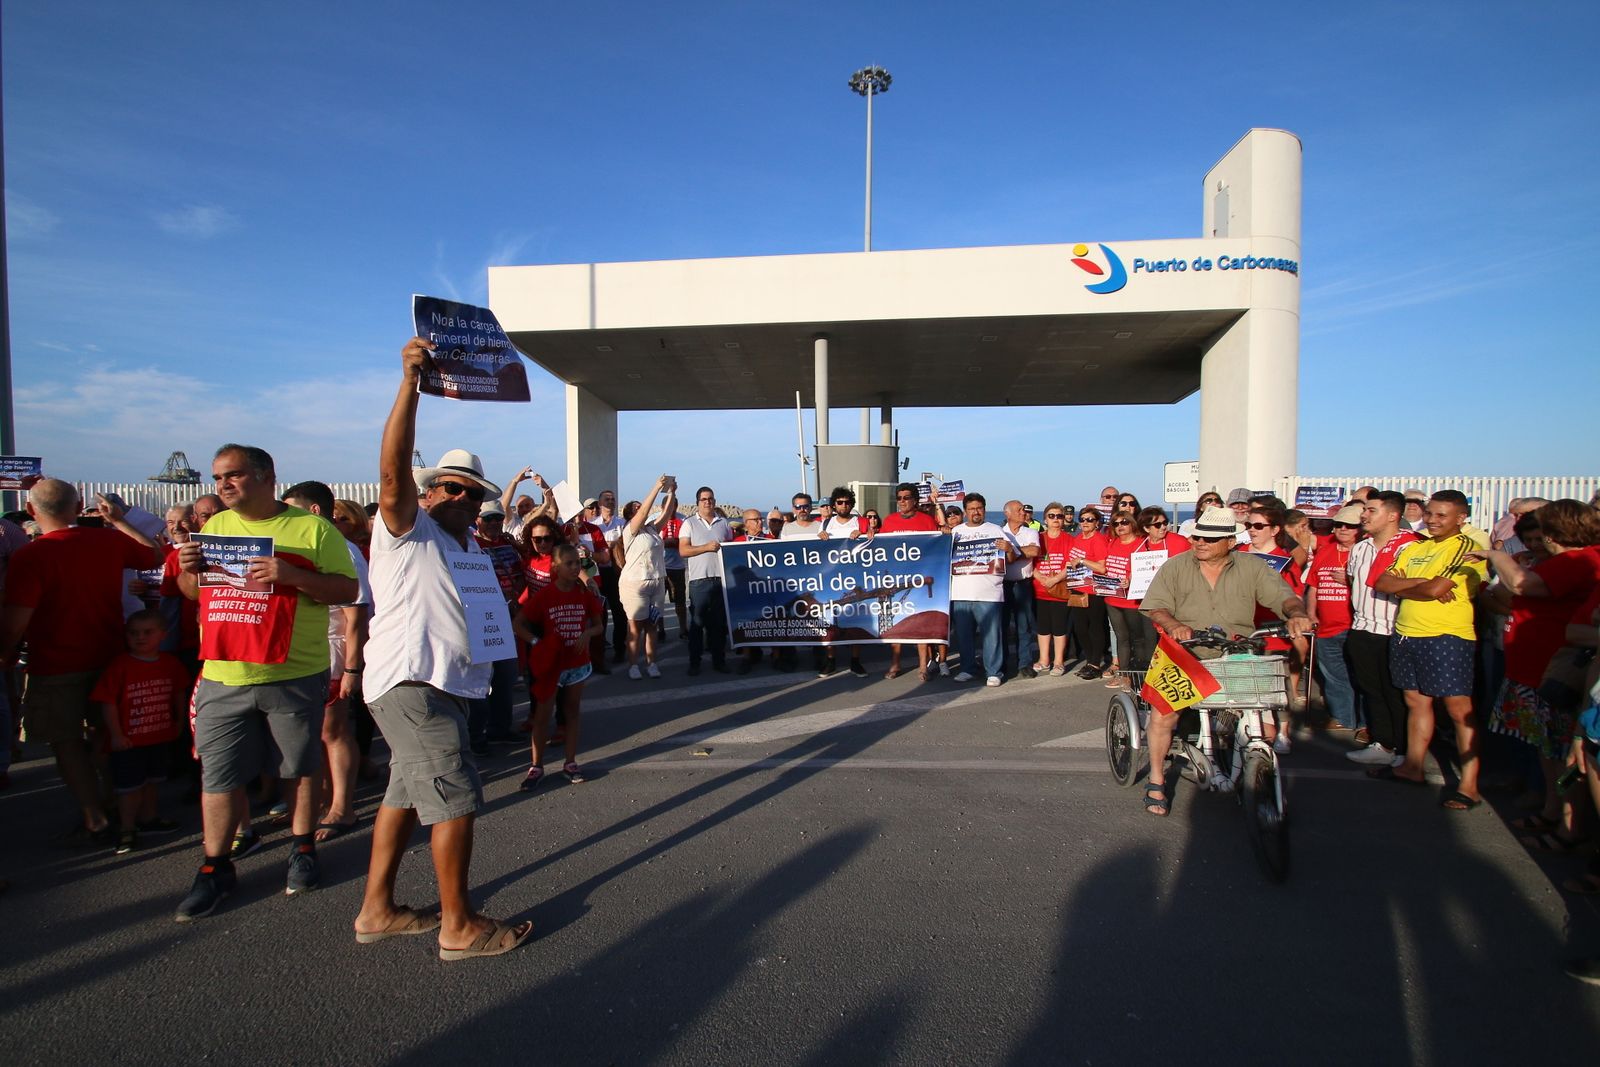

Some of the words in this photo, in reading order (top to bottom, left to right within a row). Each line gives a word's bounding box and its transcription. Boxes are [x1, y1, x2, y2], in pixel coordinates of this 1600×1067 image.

[1133, 257, 1188, 273] Puerto
[1192, 256, 1212, 272] de
[1217, 255, 1298, 277] Carboneras
[432, 311, 448, 326] No
[448, 317, 454, 327] a
[457, 316, 468, 328] la
[470, 319, 495, 333] carga
[430, 332, 471, 345] mineral
[473, 336, 485, 346] de
[435, 350, 448, 359] en
[451, 348, 510, 364] Carboneras
[224, 544, 248, 552] carga
[747, 550, 776, 569] No
[784, 552, 797, 565] a
[803, 547, 821, 565] la
[828, 548, 887, 568] carga
[894, 542, 921, 561] de
[453, 561, 489, 571] ASOCIACION
[749, 573, 823, 594] mineral
[830, 573, 856, 591] de
[864, 571, 925, 589] hierro
[461, 586, 498, 594] EMPRESARIOS
[208, 601, 245, 610] MUEVETE
[248, 602, 268, 612] POR
[761, 605, 786, 619] en
[793, 599, 915, 618] Carboneras
[208, 612, 263, 624] CARBONERAS
[485, 612, 494, 620] DE
[484, 625, 500, 633] AGUA
[738, 620, 777, 629] PLATAFORMA
[788, 619, 830, 628] ASOCIACIONES
[745, 629, 772, 637] MUEVETE
[483, 637, 504, 647] MARGA
